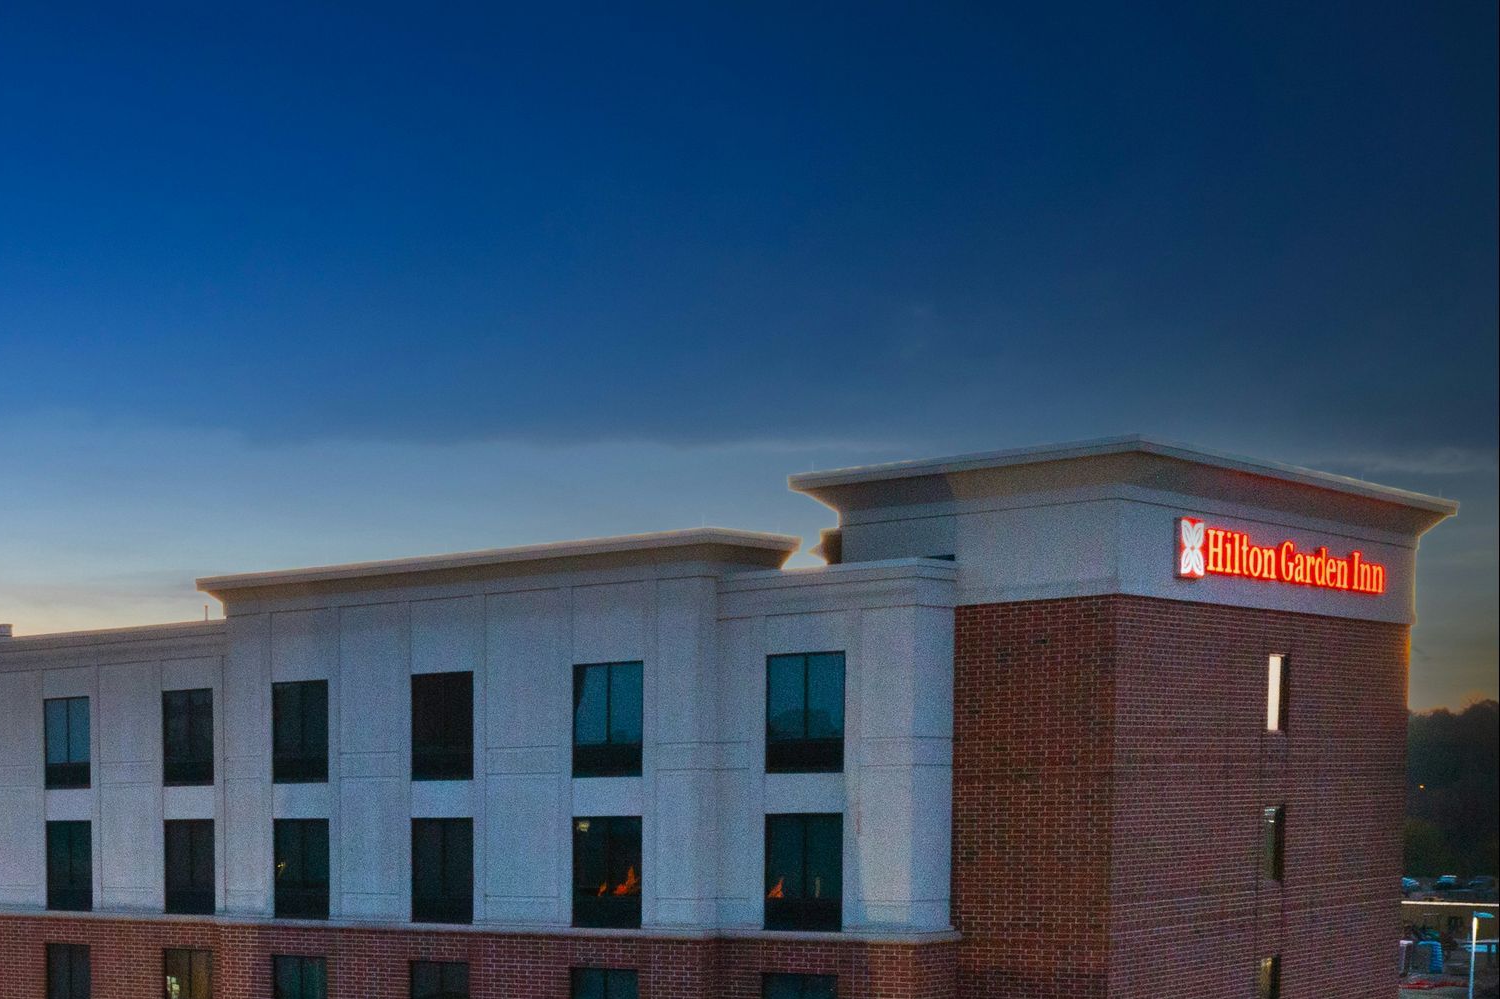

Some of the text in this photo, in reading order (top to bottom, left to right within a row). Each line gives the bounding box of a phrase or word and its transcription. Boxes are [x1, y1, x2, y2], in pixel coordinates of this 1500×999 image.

[1206, 528, 1385, 594] Hilton Garden Inn
